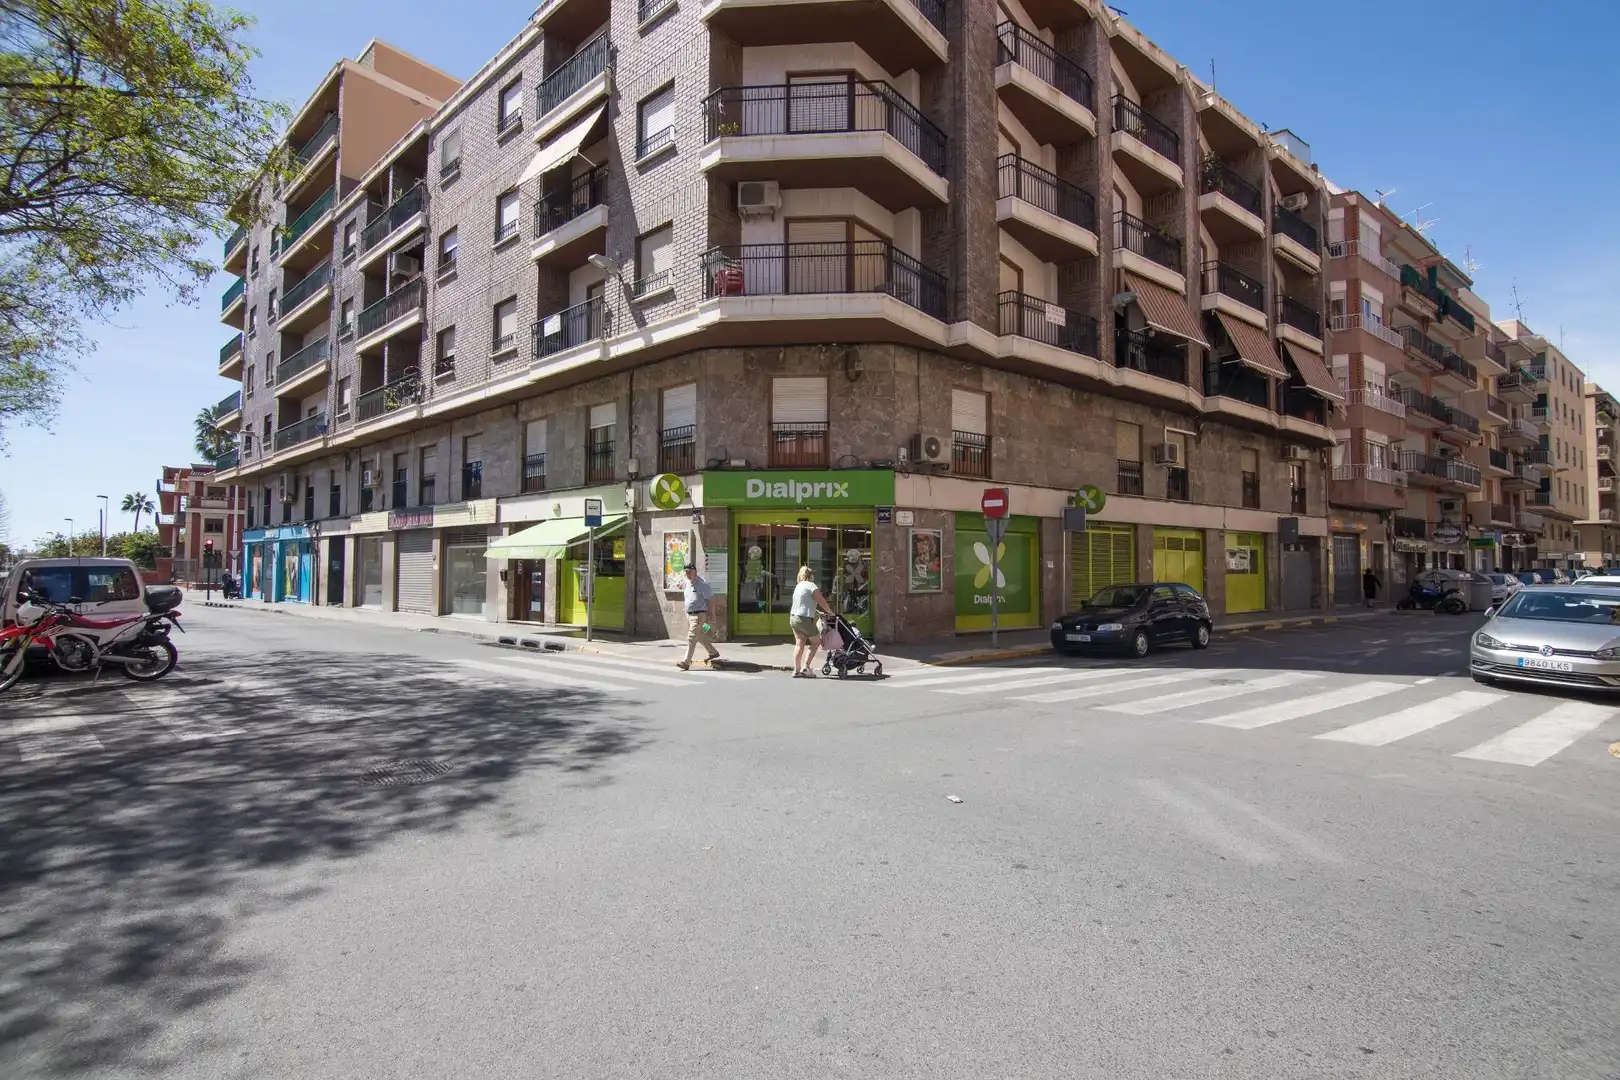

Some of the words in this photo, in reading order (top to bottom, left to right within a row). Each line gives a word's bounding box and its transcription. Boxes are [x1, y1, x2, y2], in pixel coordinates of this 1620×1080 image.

[746, 479, 849, 504] Dialprix
[1524, 659, 1548, 668] 9840
[1550, 661, 1569, 670] LKS
